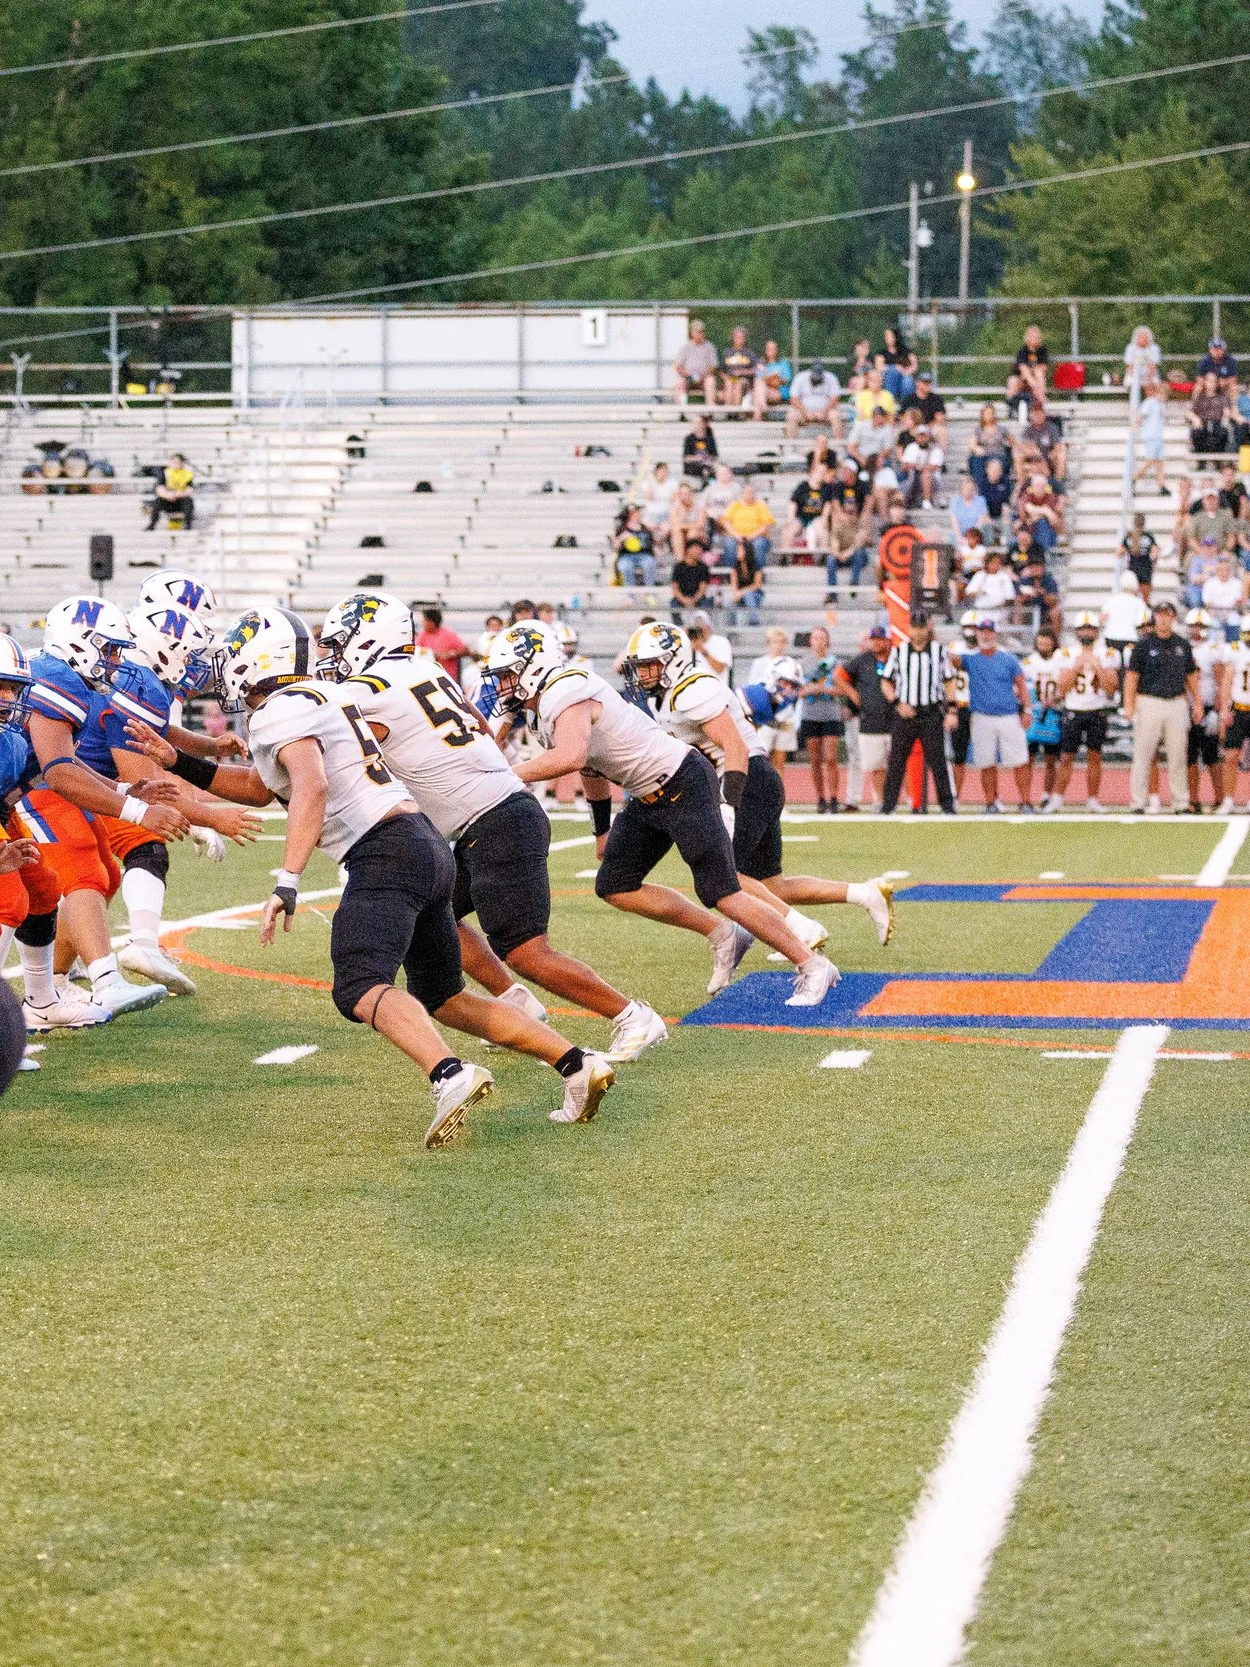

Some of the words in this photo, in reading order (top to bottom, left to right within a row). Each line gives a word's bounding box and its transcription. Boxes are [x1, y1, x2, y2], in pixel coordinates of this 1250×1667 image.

[590, 316, 598, 338] 1
[921, 548, 940, 589] 1
[176, 579, 204, 612] N
[71, 599, 105, 629] N
[159, 609, 189, 640] N
